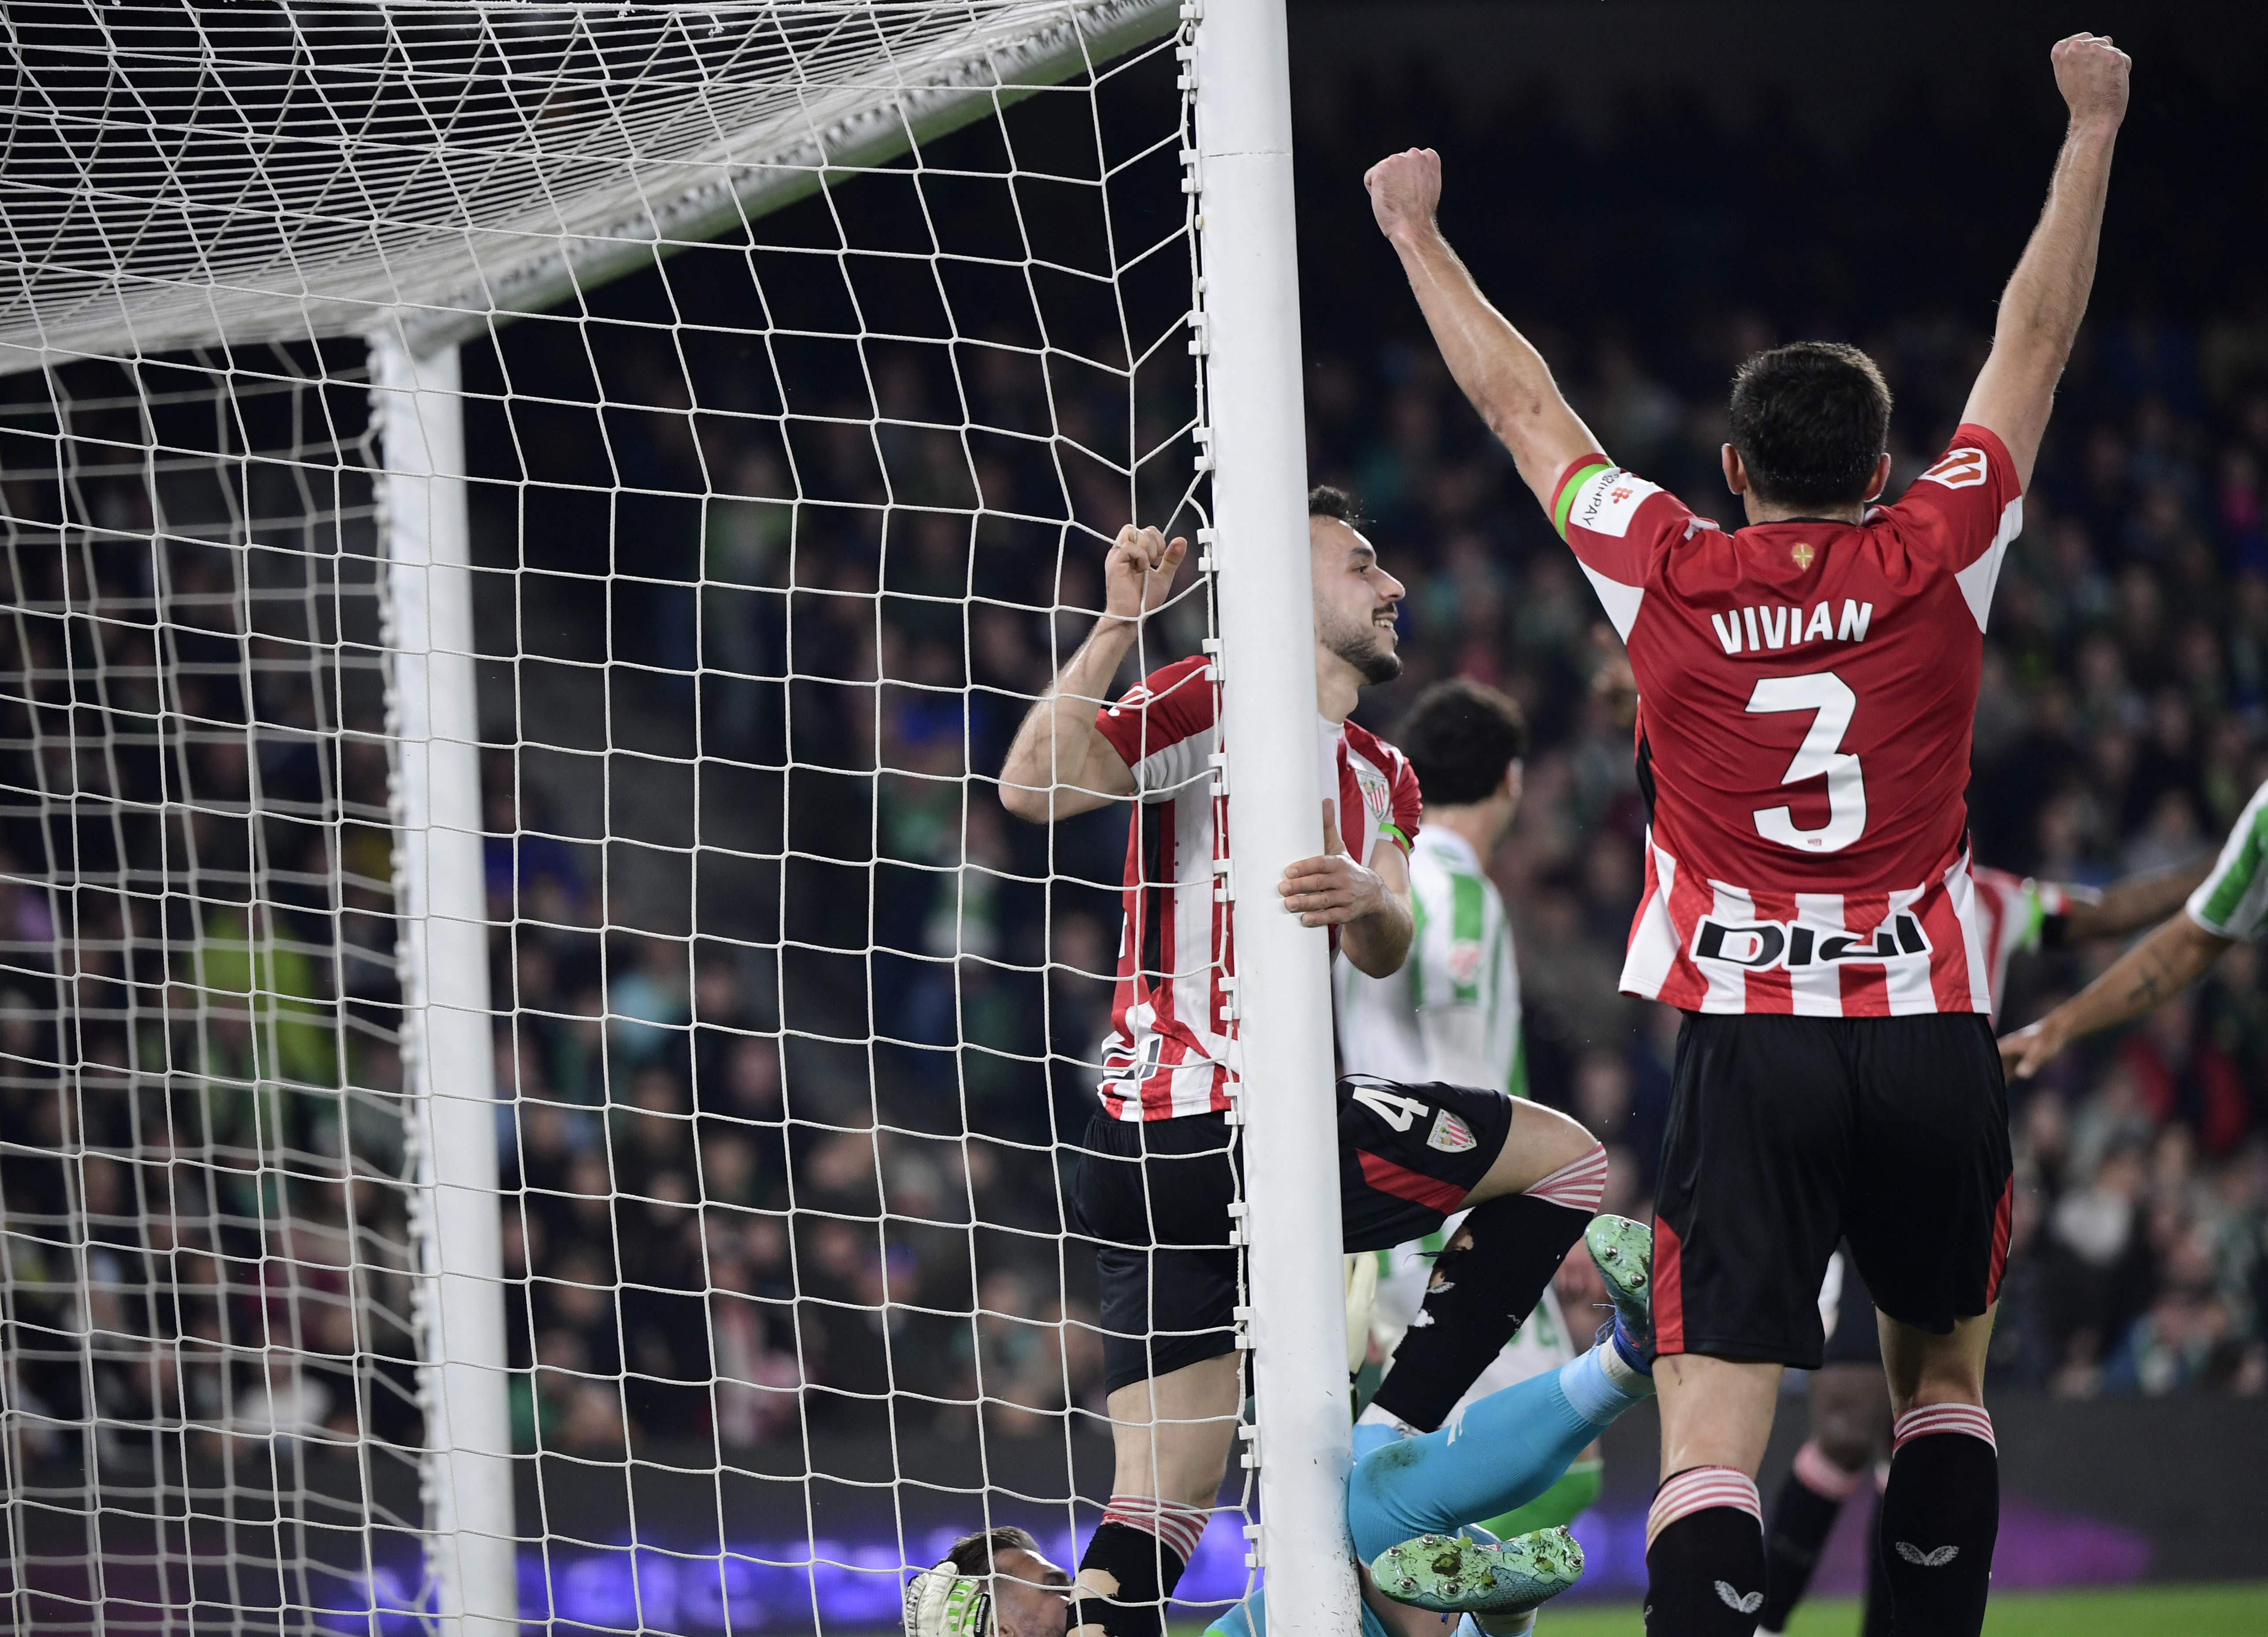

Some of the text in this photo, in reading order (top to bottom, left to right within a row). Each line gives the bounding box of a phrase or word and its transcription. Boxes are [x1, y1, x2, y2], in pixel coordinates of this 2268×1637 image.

[1711, 598, 1873, 655] VIVIAN
[1745, 672, 1867, 852] 3
[1352, 1086, 1430, 1132] 4
